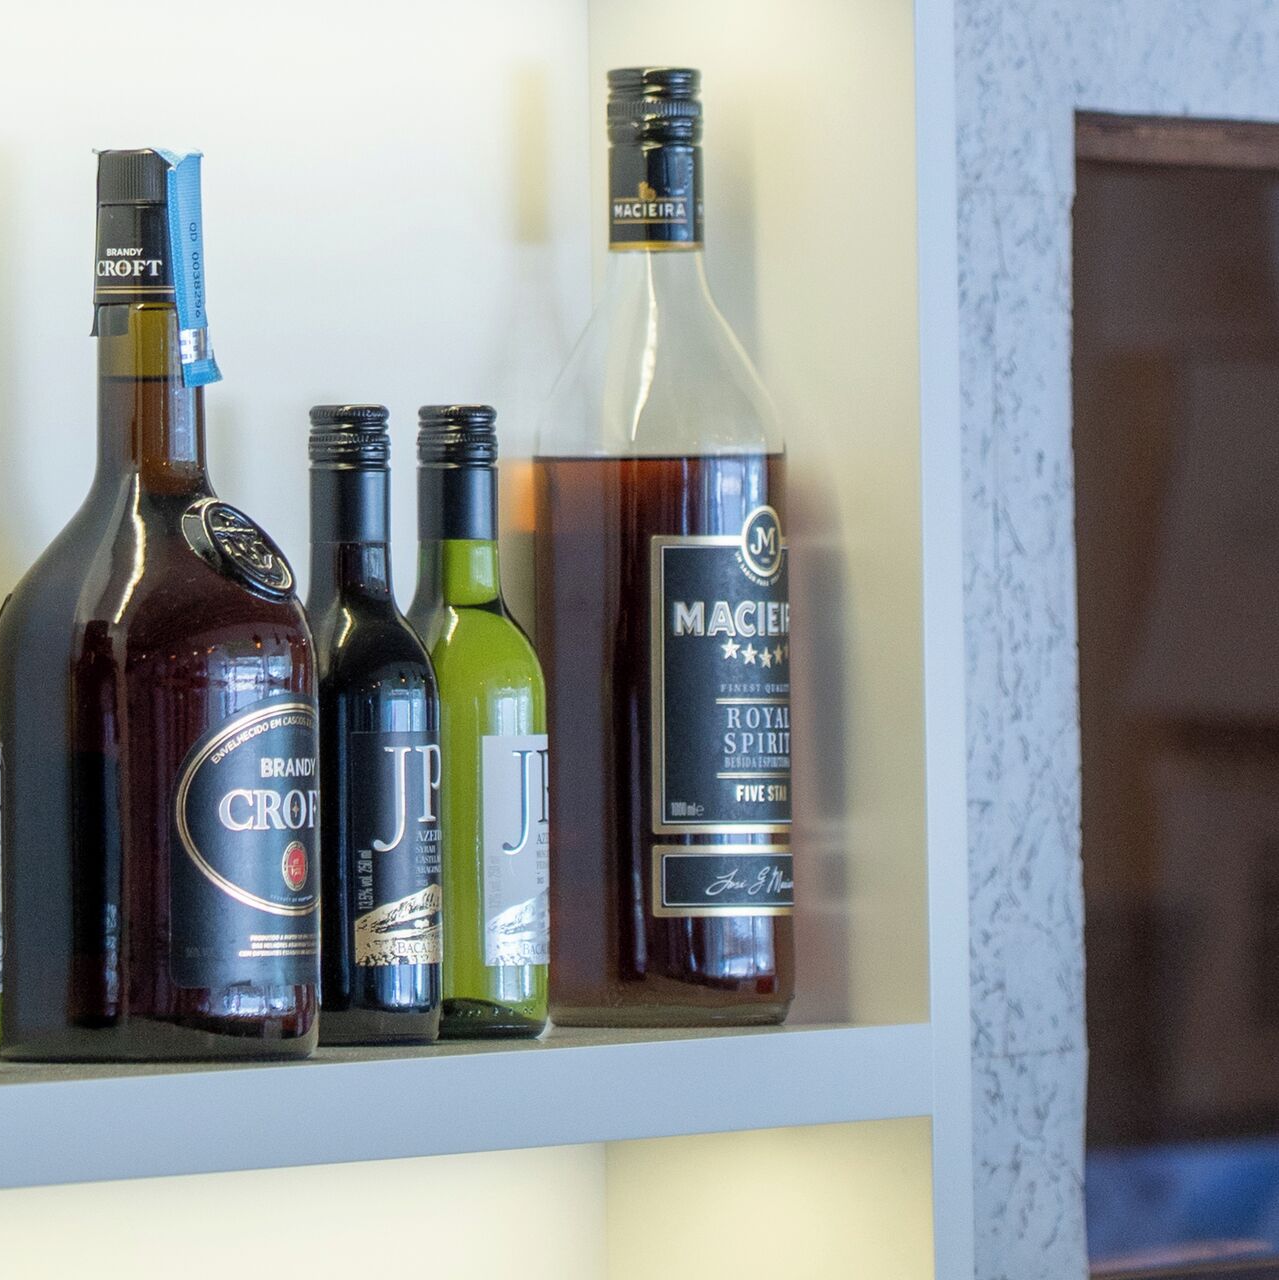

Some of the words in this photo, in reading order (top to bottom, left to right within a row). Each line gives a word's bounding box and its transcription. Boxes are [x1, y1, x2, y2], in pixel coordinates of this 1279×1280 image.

[614, 203, 686, 217] MACIEIRA
[106, 248, 143, 258] BRANDY
[97, 259, 162, 277] CROFT
[720, 683, 761, 693] FINEST
[210, 722, 269, 765] ENVELHECIDO
[269, 717, 282, 730] EM
[261, 756, 316, 778] BRANDY
[736, 784, 765, 802] FIVE
